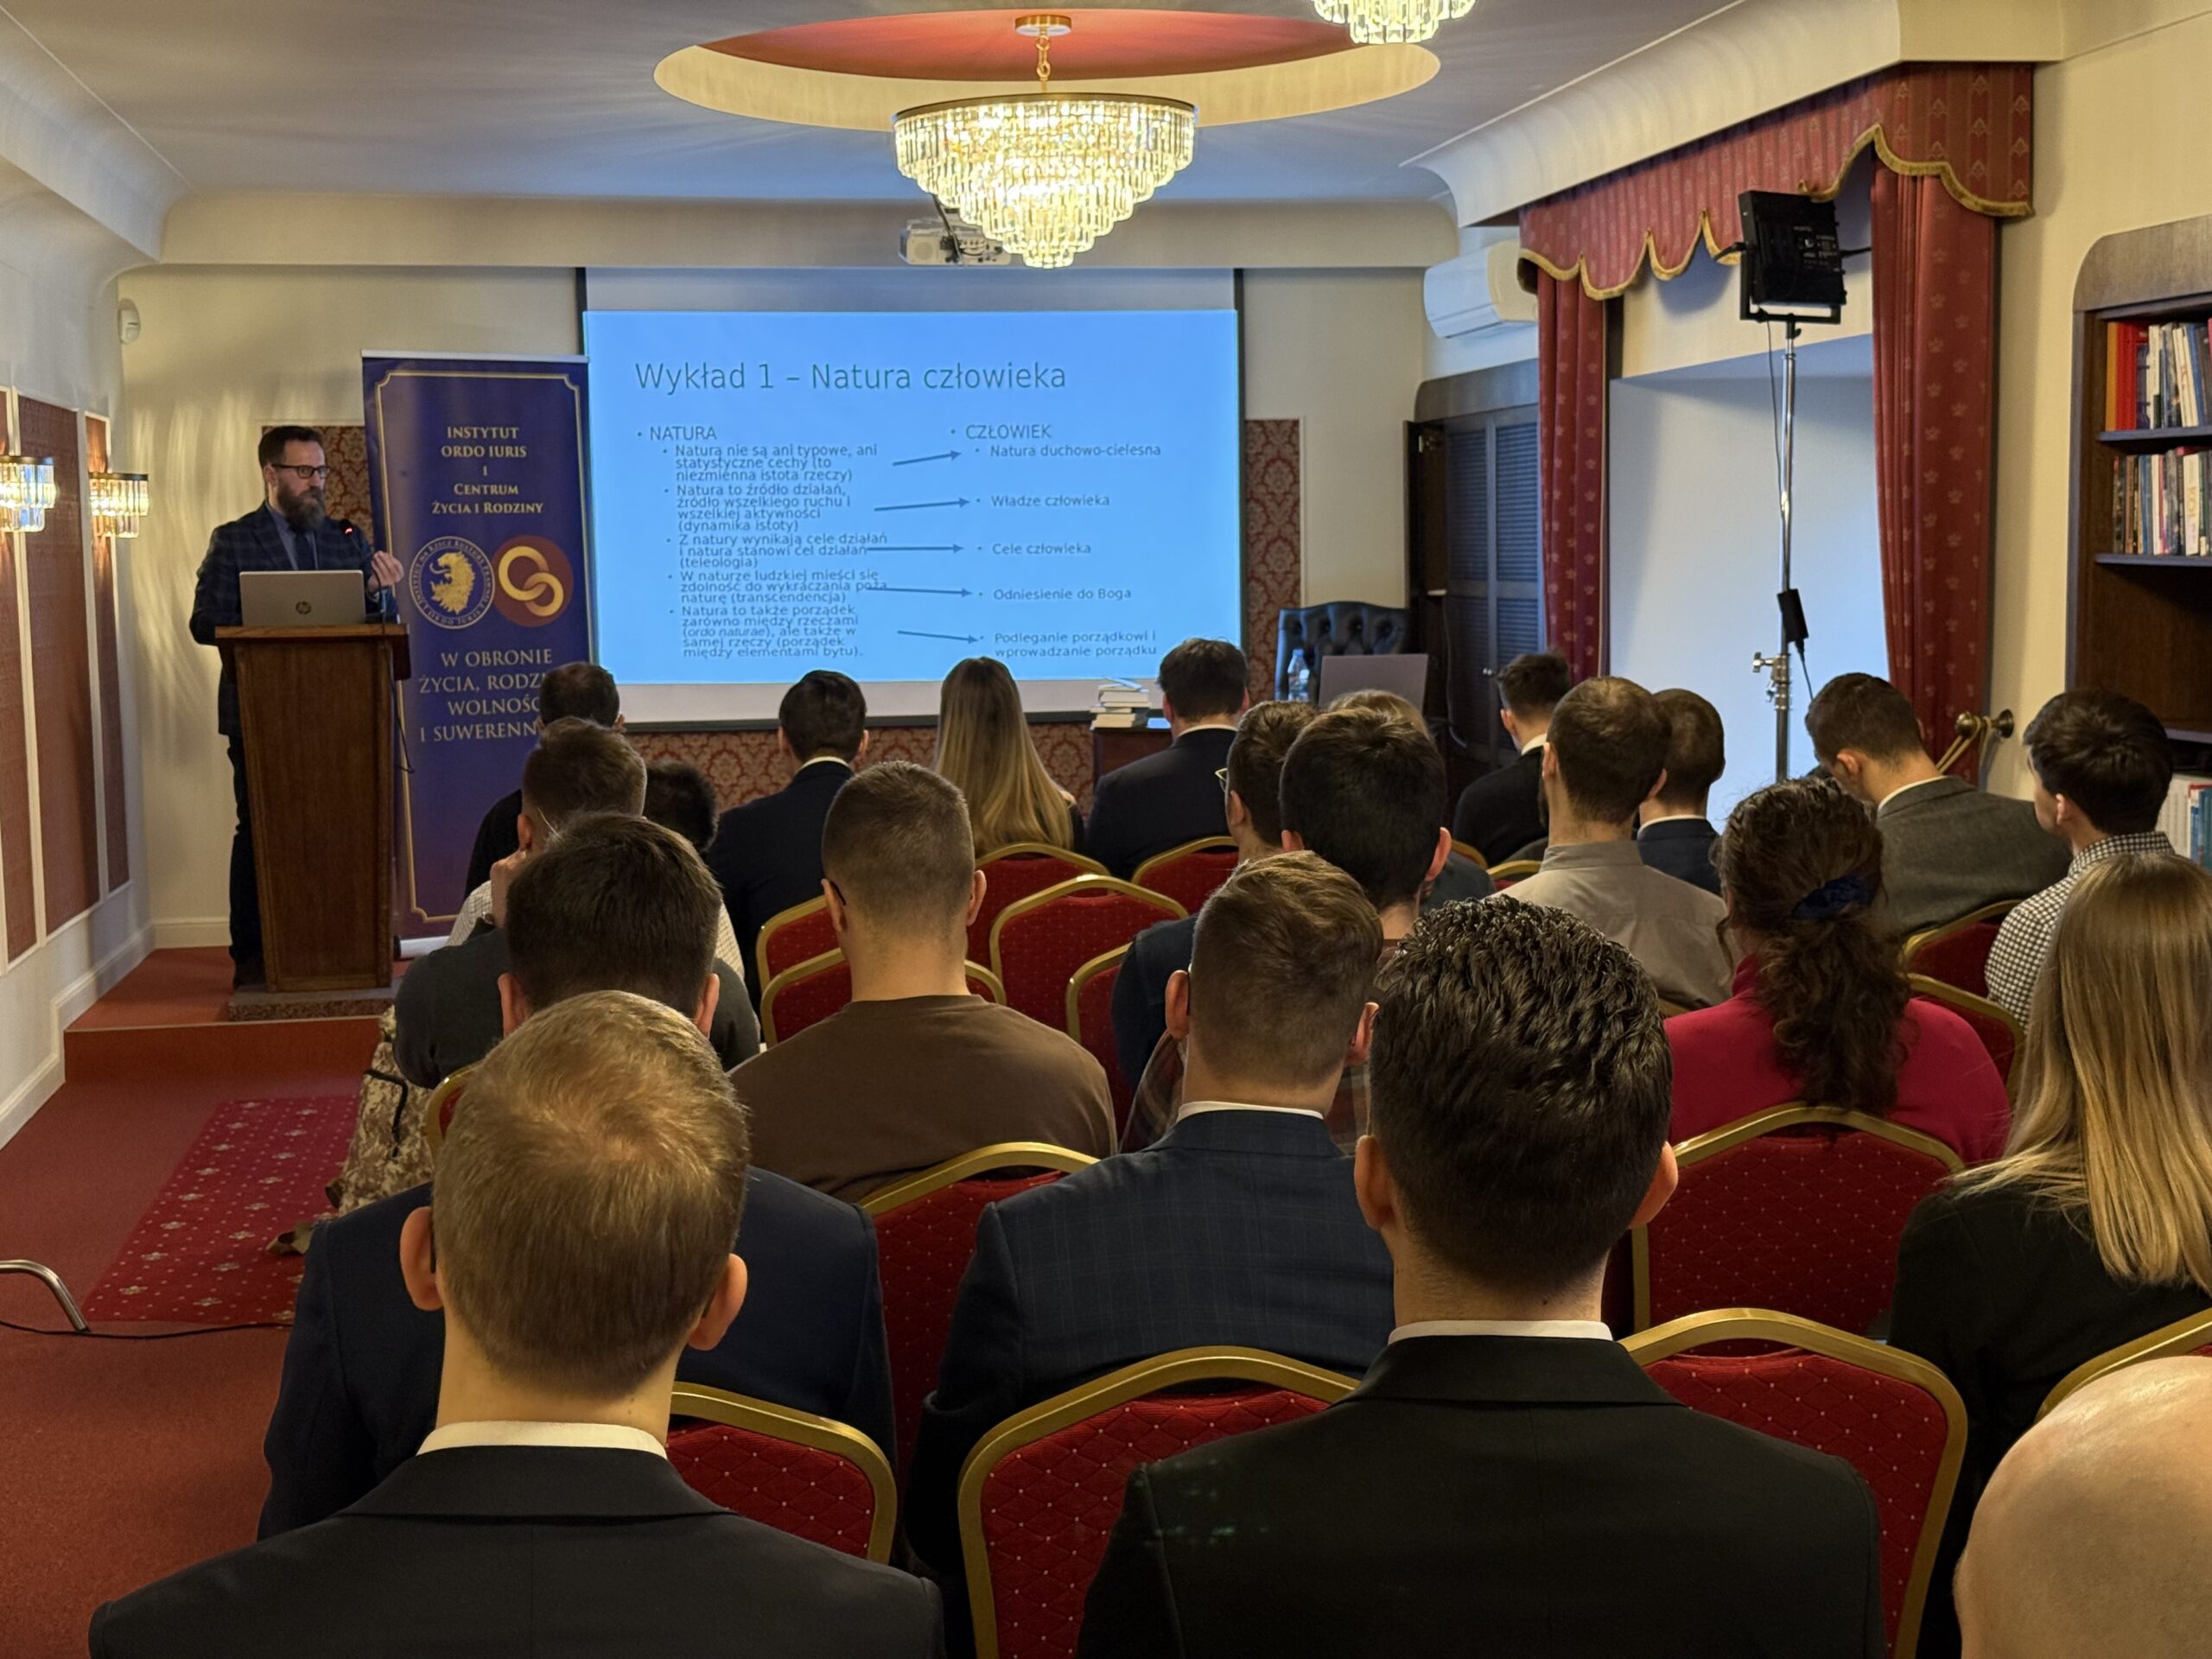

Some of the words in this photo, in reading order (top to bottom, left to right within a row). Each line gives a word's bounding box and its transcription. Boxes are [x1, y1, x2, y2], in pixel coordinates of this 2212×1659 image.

[635, 363, 745, 396] Wykład
[760, 365, 774, 389] 1
[812, 364, 911, 389] Natura
[924, 362, 1066, 389] człowieka
[447, 426, 519, 439] INSTYTUT
[650, 427, 716, 440] NATURA
[965, 424, 1052, 439] CZŁOWIEK
[441, 446, 485, 457] ORDO
[489, 446, 526, 458] IURIS
[676, 445, 721, 456] Natura
[728, 445, 748, 456] nie
[753, 447, 767, 458] są
[773, 445, 793, 455] ani
[798, 445, 852, 458] typowe,
[856, 444, 877, 455] ani
[990, 445, 1035, 457] Natura
[1040, 443, 1160, 456] duchowo-cielesna
[676, 458, 763, 470] statystyczne
[768, 458, 807, 470] cechy
[812, 457, 831, 469] (to
[483, 466, 487, 476] I
[677, 470, 755, 481] niezmienna
[760, 470, 798, 480] istota
[804, 470, 852, 482] rzeczy)
[677, 485, 723, 495] Natura
[728, 486, 741, 495] to
[747, 484, 788, 495] źródło
[793, 484, 846, 496] działań,
[677, 496, 719, 508] źródło
[724, 496, 798, 509] wszelkiego
[804, 496, 842, 507] ruchu
[847, 496, 851, 506] i
[991, 495, 1040, 506] Władze
[1045, 494, 1109, 506] człowieka
[677, 508, 740, 520] wszelkiej
[745, 508, 820, 520] aktywności
[678, 520, 750, 532] (dynamika
[756, 520, 798, 533] istoty)
[679, 534, 688, 544] Z
[693, 535, 737, 546] natury
[742, 534, 801, 546] wynikają
[807, 534, 834, 544] cele
[839, 533, 887, 544] działań
[688, 546, 733, 556] natura
[737, 545, 790, 556] stanowi
[795, 545, 814, 556] cel
[819, 545, 868, 556] działań
[992, 543, 1022, 555] Cele
[1027, 543, 1091, 555] człowieka
[680, 556, 758, 568] (teleologia)
[680, 571, 694, 581] W
[698, 572, 750, 582] naturze
[755, 570, 807, 582] ludzkiej
[812, 570, 855, 581] mieści
[860, 569, 878, 582] się
[681, 582, 740, 593] zdolność
[746, 582, 761, 592] do
[766, 582, 850, 593] wykraczania
[682, 594, 726, 604] naturę
[731, 592, 845, 604] (transcendencja)
[994, 588, 1072, 600] Odniesienie
[1077, 588, 1093, 600] do
[1098, 588, 1131, 601] Boga
[682, 606, 728, 616] Natura
[733, 607, 746, 615] to
[751, 605, 788, 615] także
[793, 605, 855, 617] porządek
[683, 616, 740, 626] zarówno
[744, 616, 793, 628] między
[798, 616, 858, 626] rzeczami
[683, 626, 715, 638] (ordo
[720, 626, 774, 638] naturae),
[779, 626, 799, 637] ale
[804, 626, 841, 636] także
[995, 632, 1067, 645] Podleganie
[1072, 631, 1148, 643] porządkowi
[1153, 631, 1156, 640] i
[683, 638, 723, 648] samej
[728, 638, 772, 647] rzeczy
[777, 637, 844, 647] (porządek
[441, 652, 458, 667] W
[465, 649, 552, 666] OBRONIE
[683, 648, 731, 659] między
[737, 647, 818, 658] elementami
[823, 647, 863, 658] bytu).
[995, 645, 1090, 658] wprowadzanie
[1096, 645, 1157, 657] porządku
[419, 674, 480, 694] ŻYCIA,
[420, 727, 425, 742] I
